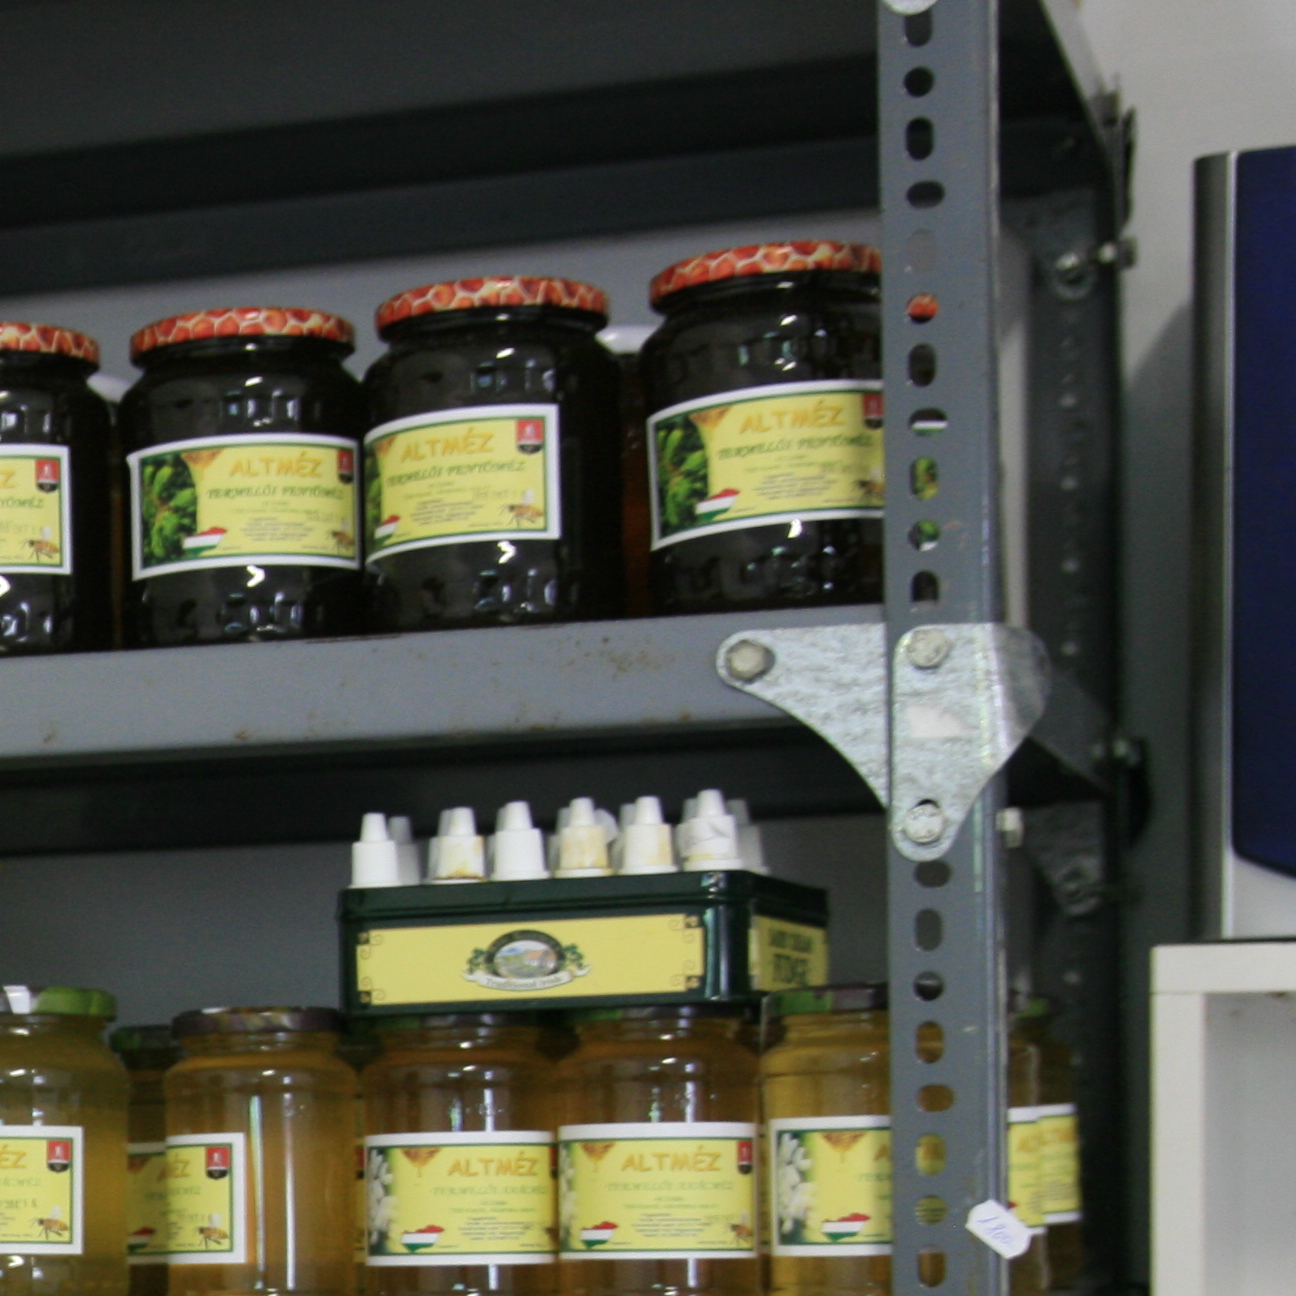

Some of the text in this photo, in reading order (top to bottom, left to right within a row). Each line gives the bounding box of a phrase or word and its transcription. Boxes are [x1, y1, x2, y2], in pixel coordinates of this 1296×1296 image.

[739, 400, 846, 435] ALTMÉZ
[401, 426, 494, 463] ALTMÉZ
[229, 451, 323, 477] ALTMÉZ
[447, 1151, 540, 1177] ALTMÉZ
[621, 1145, 722, 1172] ALTMÉZ
